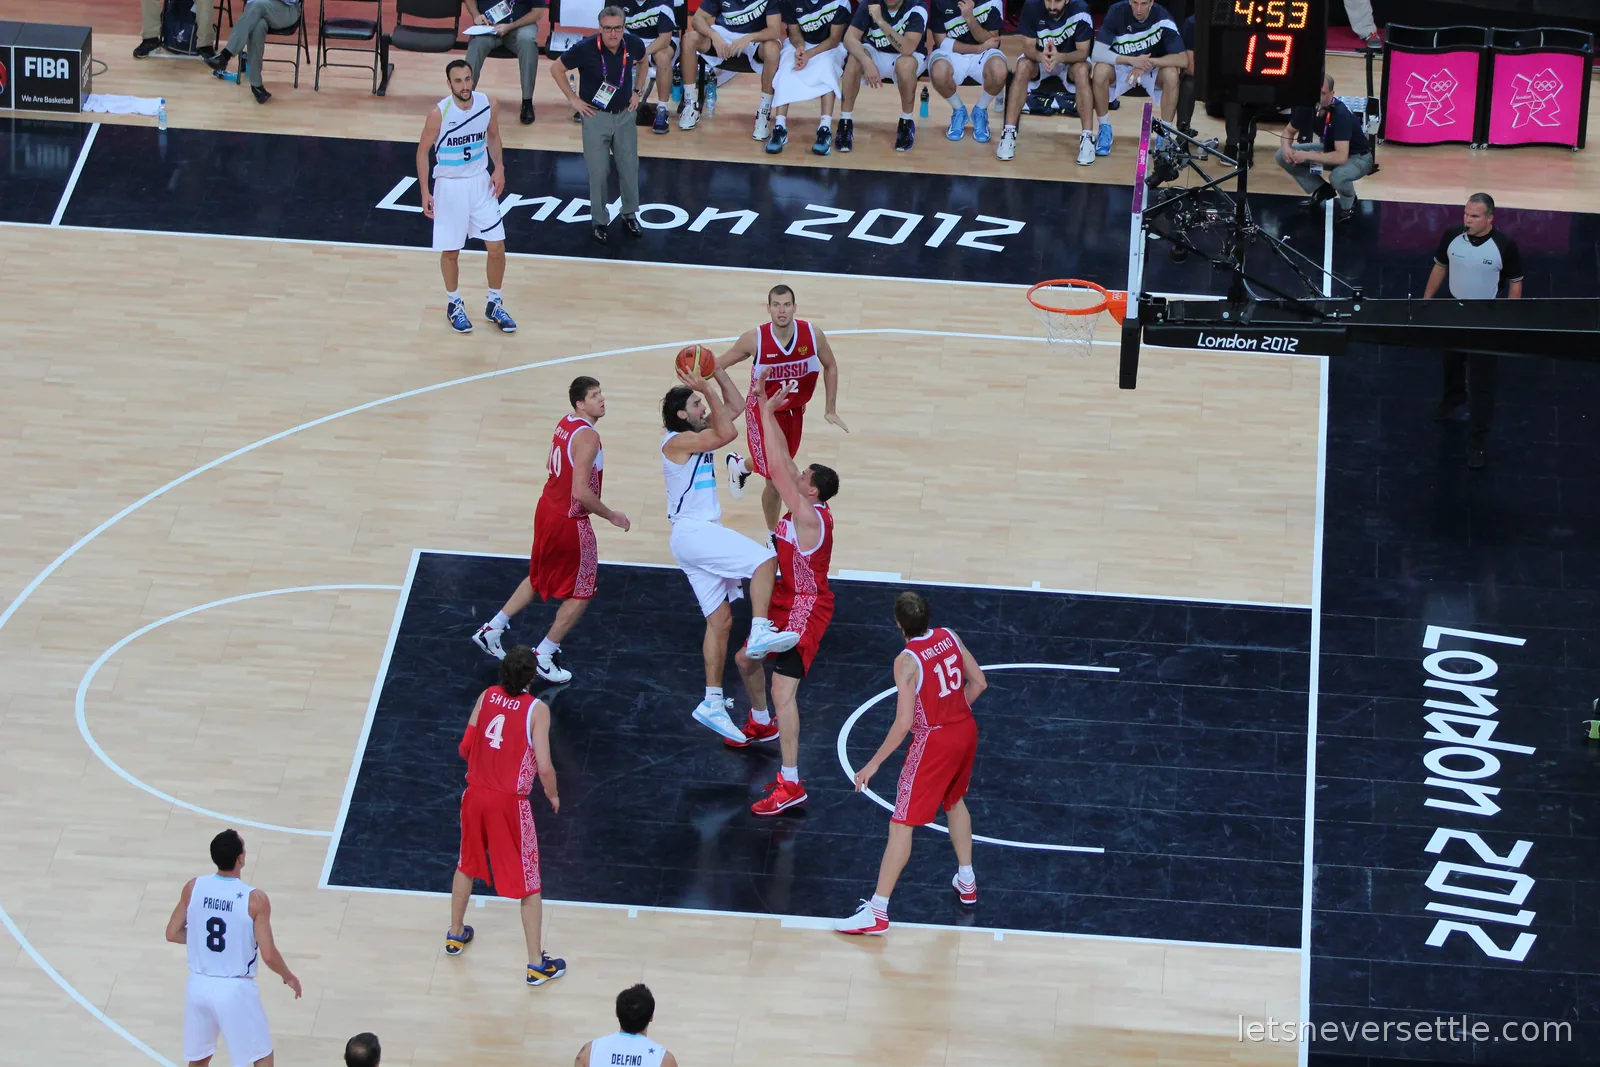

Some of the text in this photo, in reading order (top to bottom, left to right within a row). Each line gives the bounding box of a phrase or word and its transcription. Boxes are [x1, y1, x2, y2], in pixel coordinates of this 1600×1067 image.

[1234, 0, 1308, 28] 4:53
[1244, 34, 1293, 75] 13
[24, 56, 70, 79] FIBA
[21, 94, 74, 105] We Are Basketball
[463, 146, 472, 162] 5
[375, 176, 1027, 252] Lndon 2012
[1197, 332, 1299, 352] London 2012
[768, 361, 809, 379] RUSSIA
[780, 379, 799, 393] 12
[933, 653, 962, 698] 15
[489, 692, 521, 711] SHVED
[484, 713, 506, 750] 4
[1422, 624, 1538, 962] London 2012
[203, 896, 234, 913] PRIGIONI
[206, 916, 227, 953] 8
[611, 1053, 643, 1067] DELFINO
